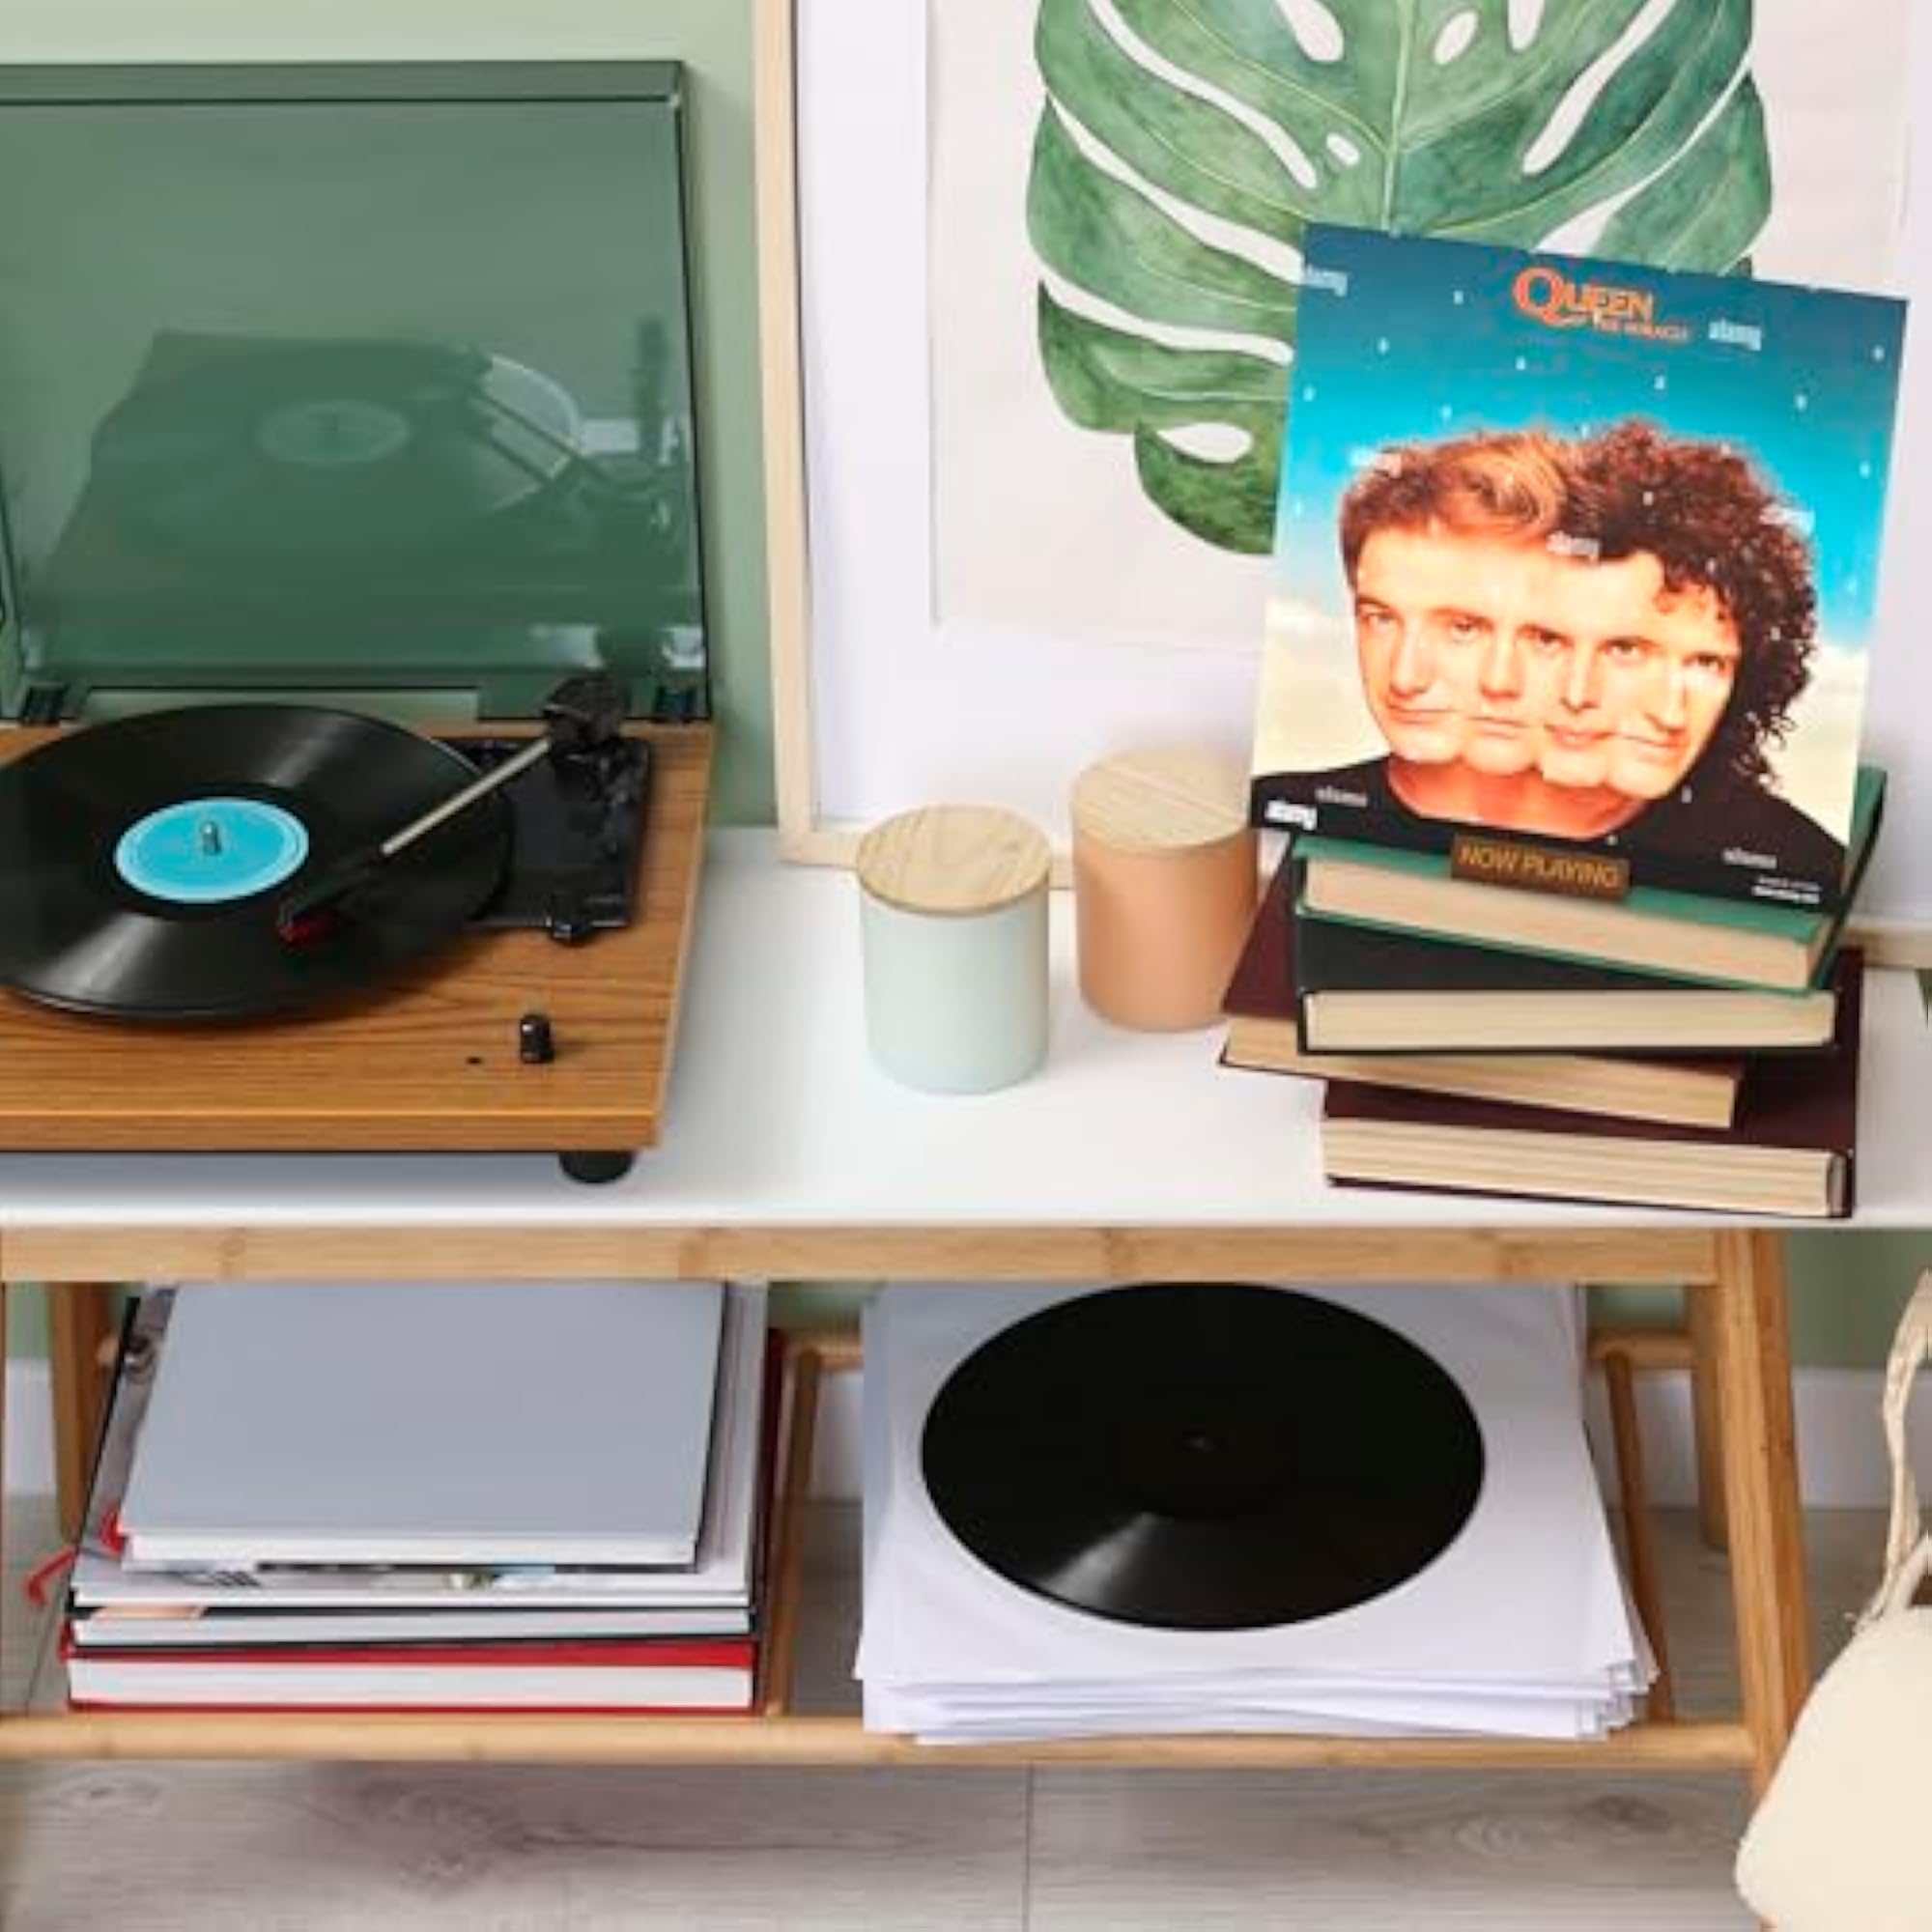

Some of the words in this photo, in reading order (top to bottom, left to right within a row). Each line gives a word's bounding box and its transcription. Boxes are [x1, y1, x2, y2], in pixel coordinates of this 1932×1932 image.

[1512, 267, 1655, 327] QUEEN
[1459, 842, 1518, 873] NOW
[1523, 852, 1620, 889] PLAYING
